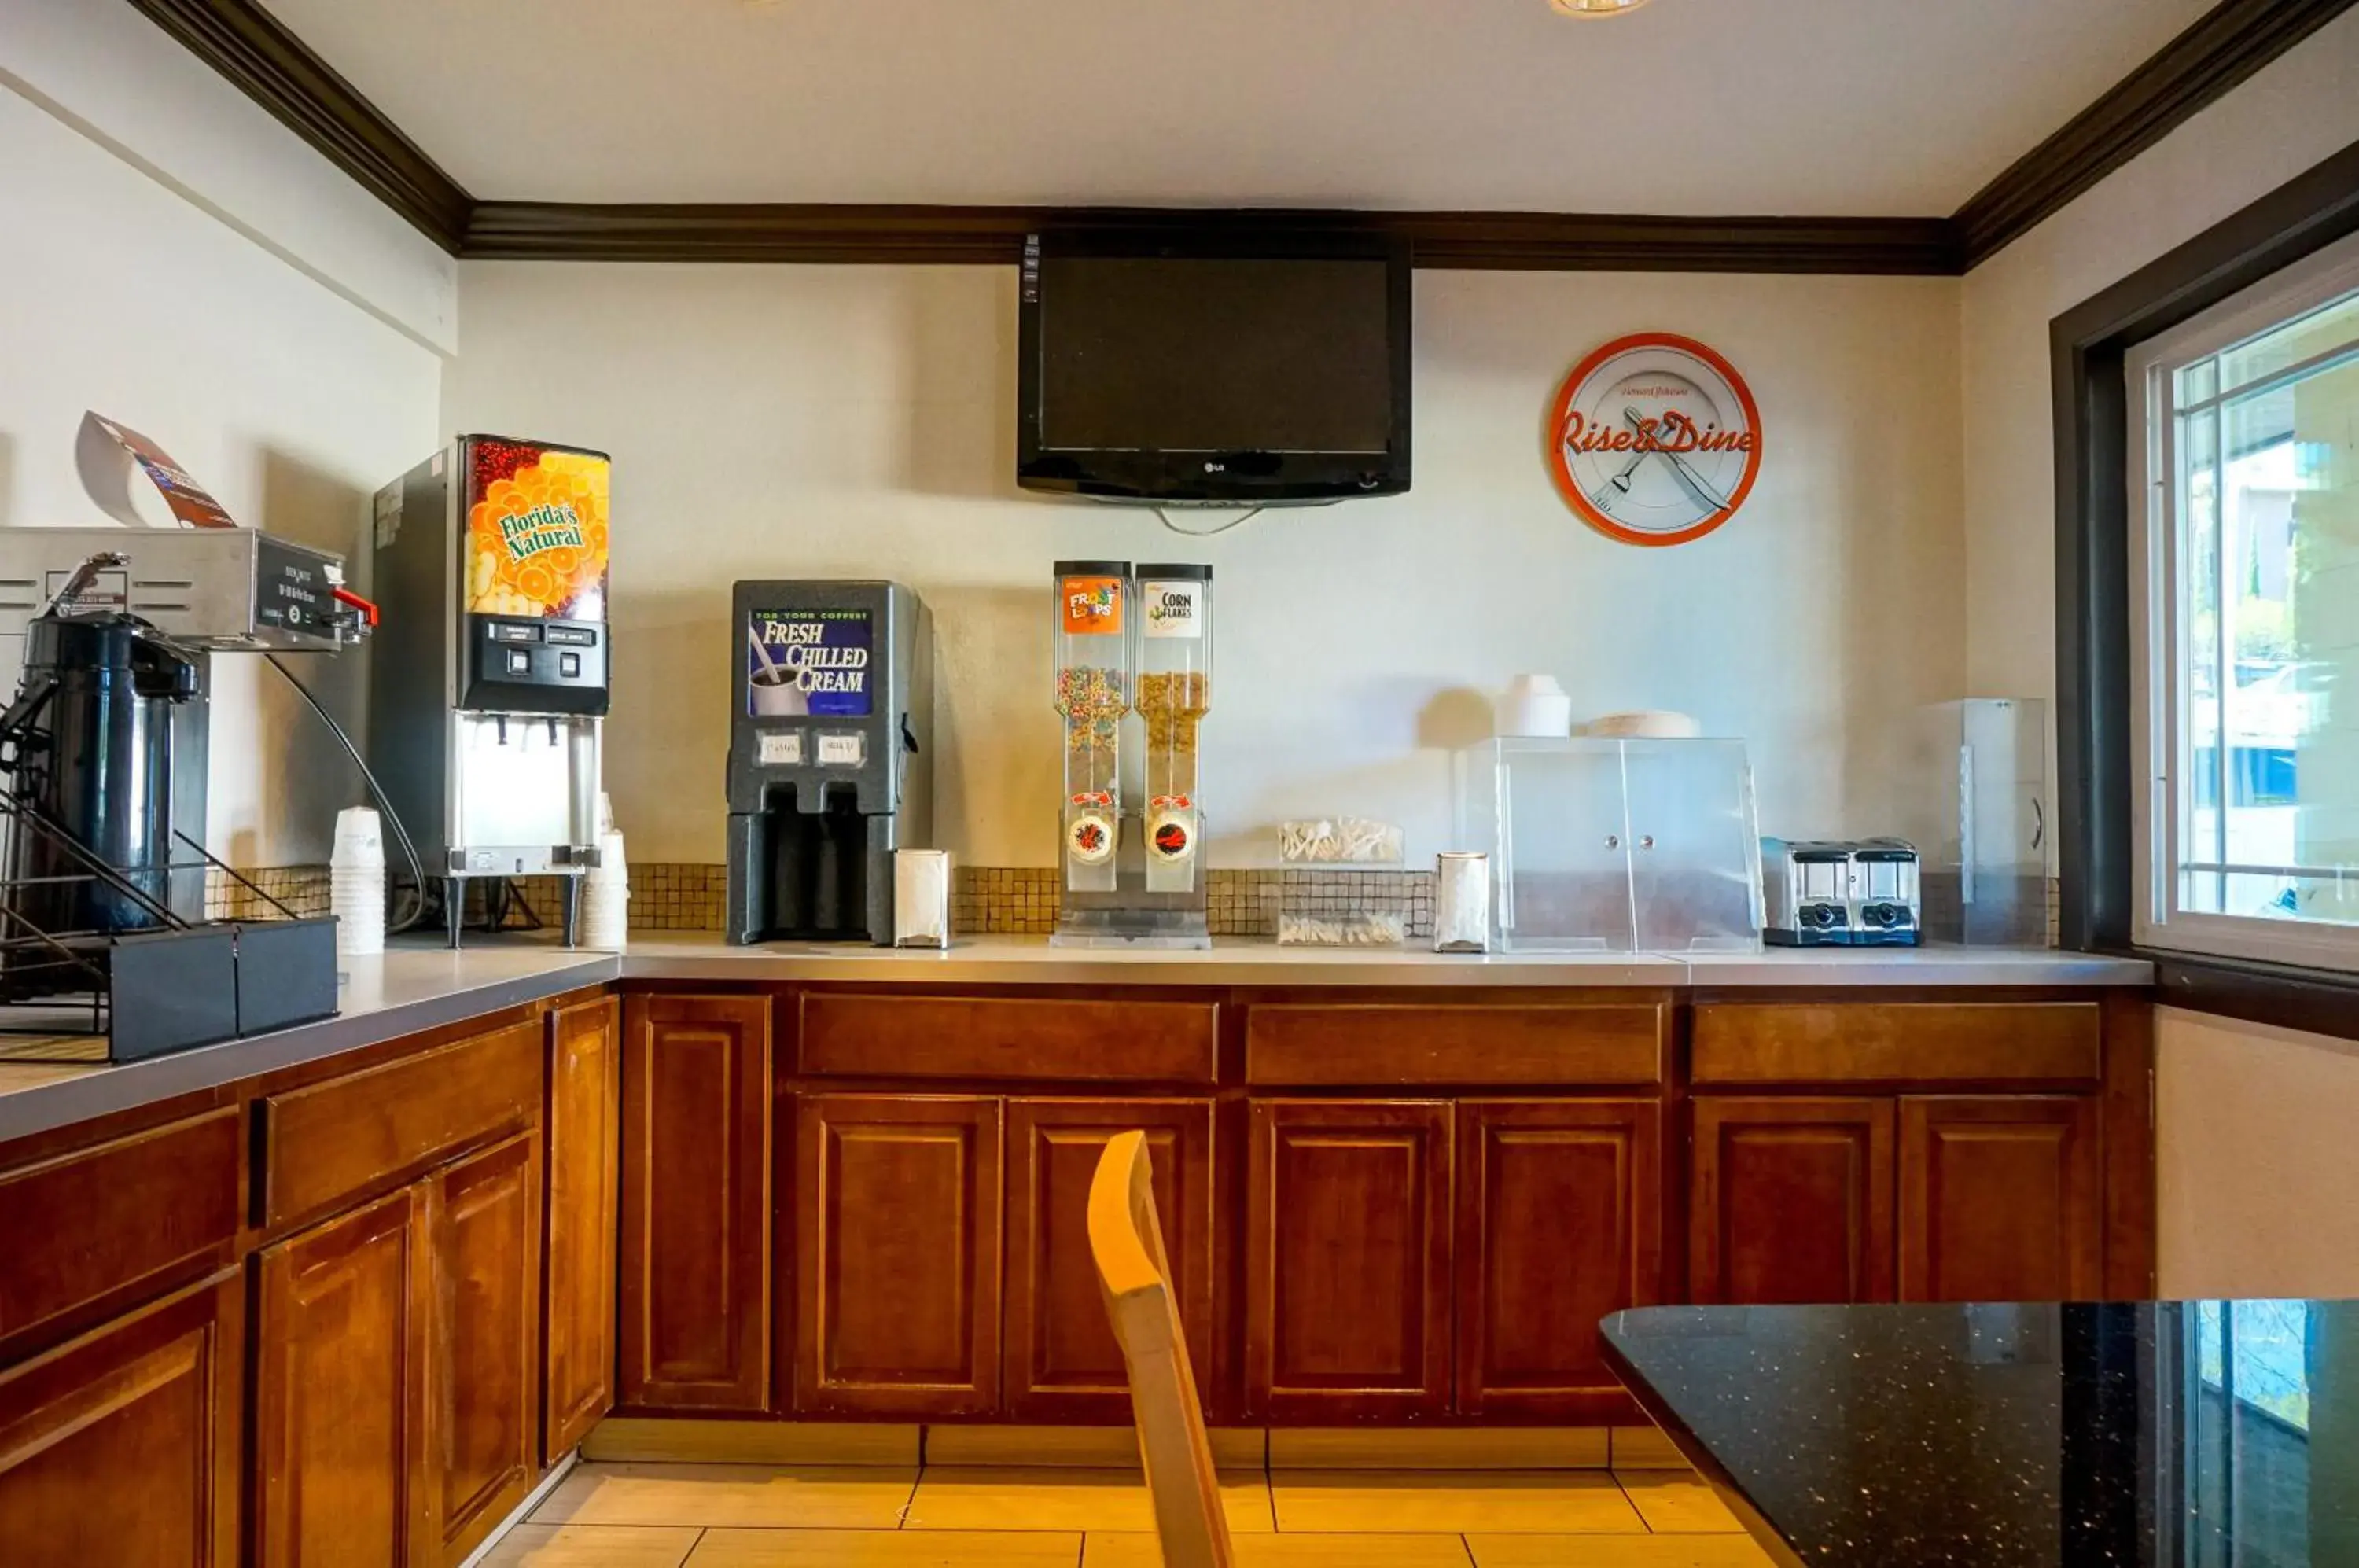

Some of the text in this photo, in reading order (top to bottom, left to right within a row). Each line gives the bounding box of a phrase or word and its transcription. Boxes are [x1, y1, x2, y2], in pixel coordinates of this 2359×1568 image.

[1556, 410, 1632, 455] Rise
[1659, 409, 1754, 452] Dine
[499, 503, 579, 539] Florida's
[508, 526, 584, 561] Natural
[1161, 591, 1191, 607] CORN
[1162, 607, 1192, 619] FLAKES
[763, 620, 824, 644] FRESH
[786, 644, 867, 668] CHILLED
[796, 668, 864, 692] CREAM
